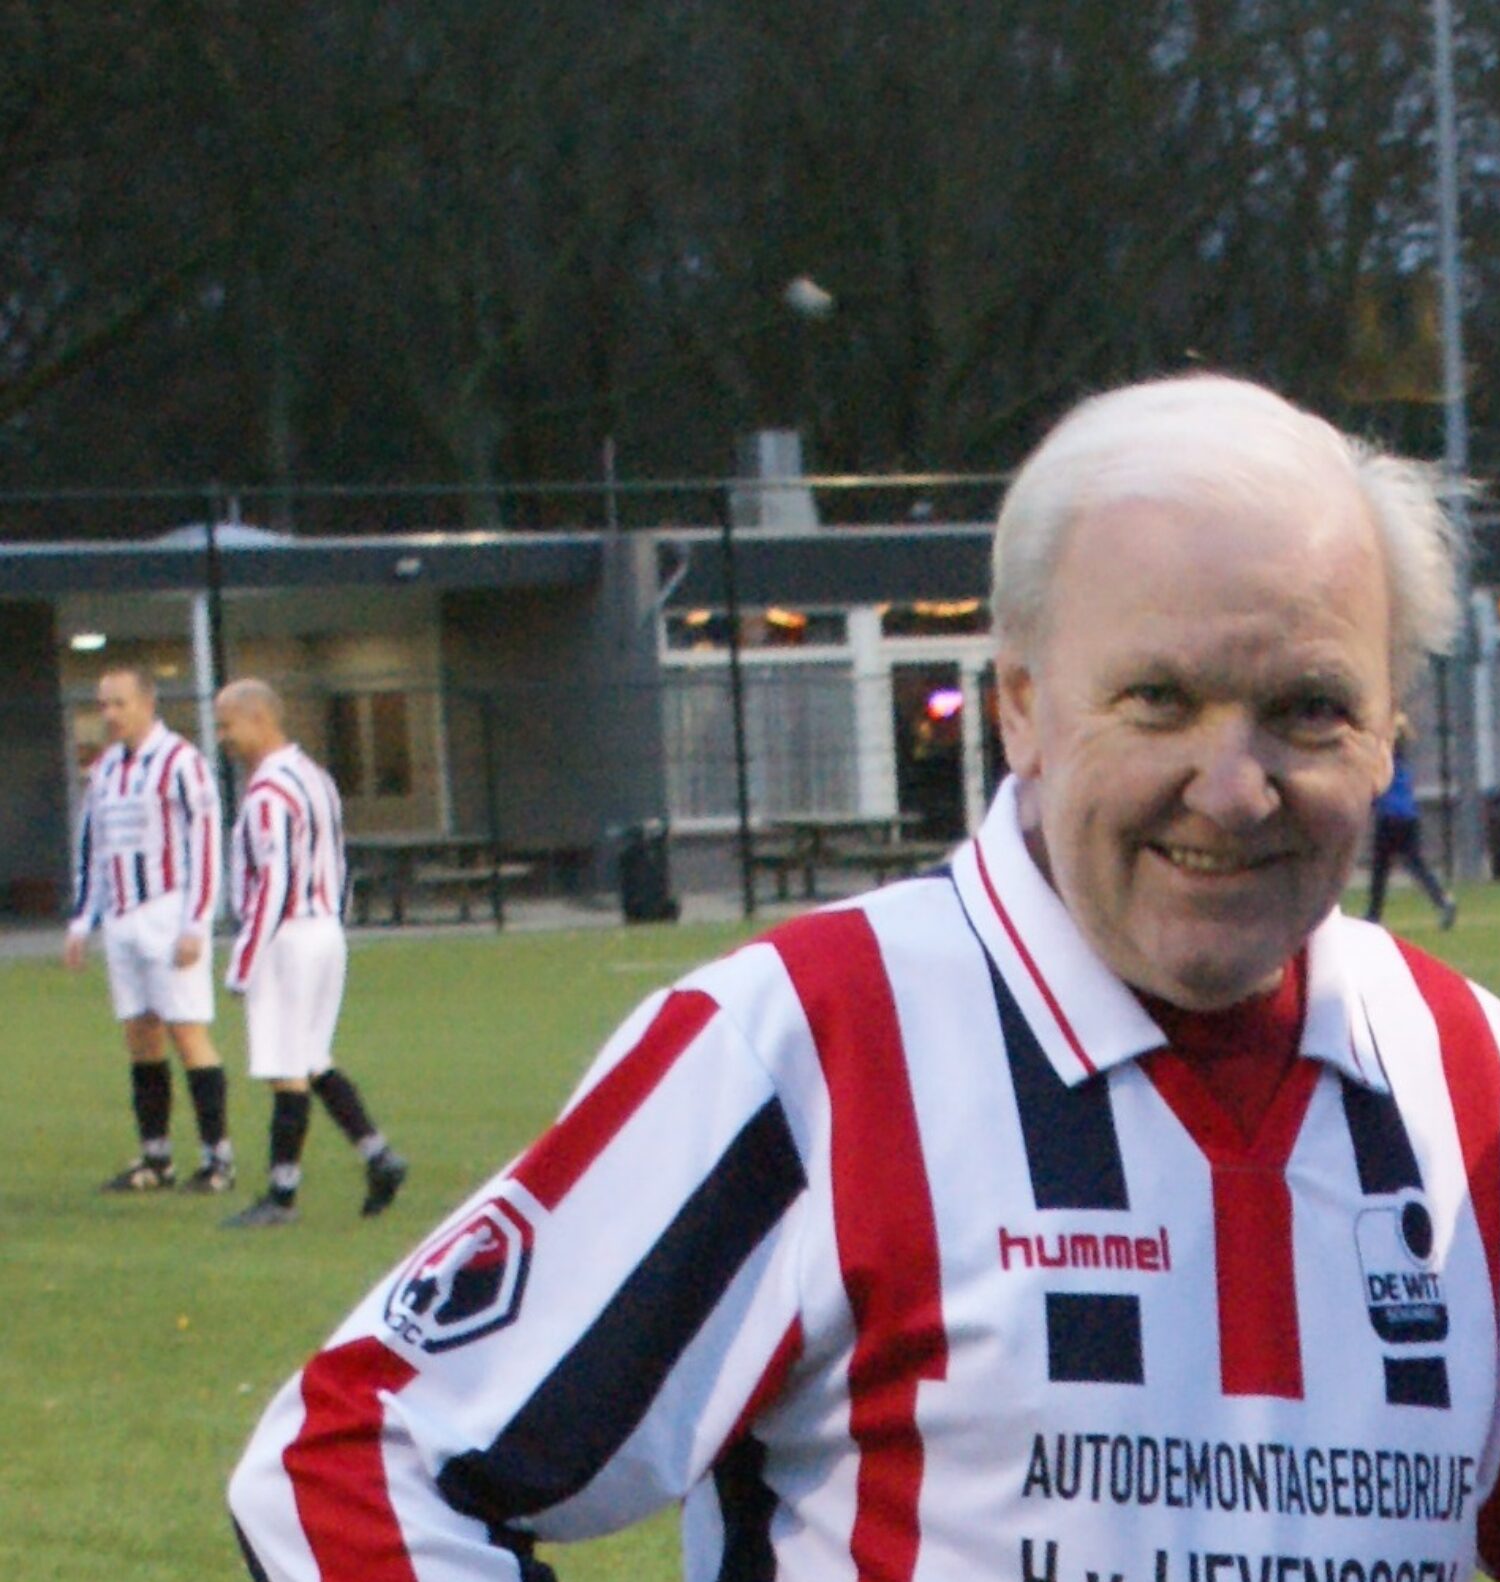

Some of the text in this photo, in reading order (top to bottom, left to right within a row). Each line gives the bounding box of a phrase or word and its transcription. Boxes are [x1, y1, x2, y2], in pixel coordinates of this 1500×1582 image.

[998, 1226, 1171, 1271] hummel
[1367, 1272, 1440, 1301] DE WIT
[1022, 1433, 1475, 1522] AUTODEMONTAGEBEDRIJF
